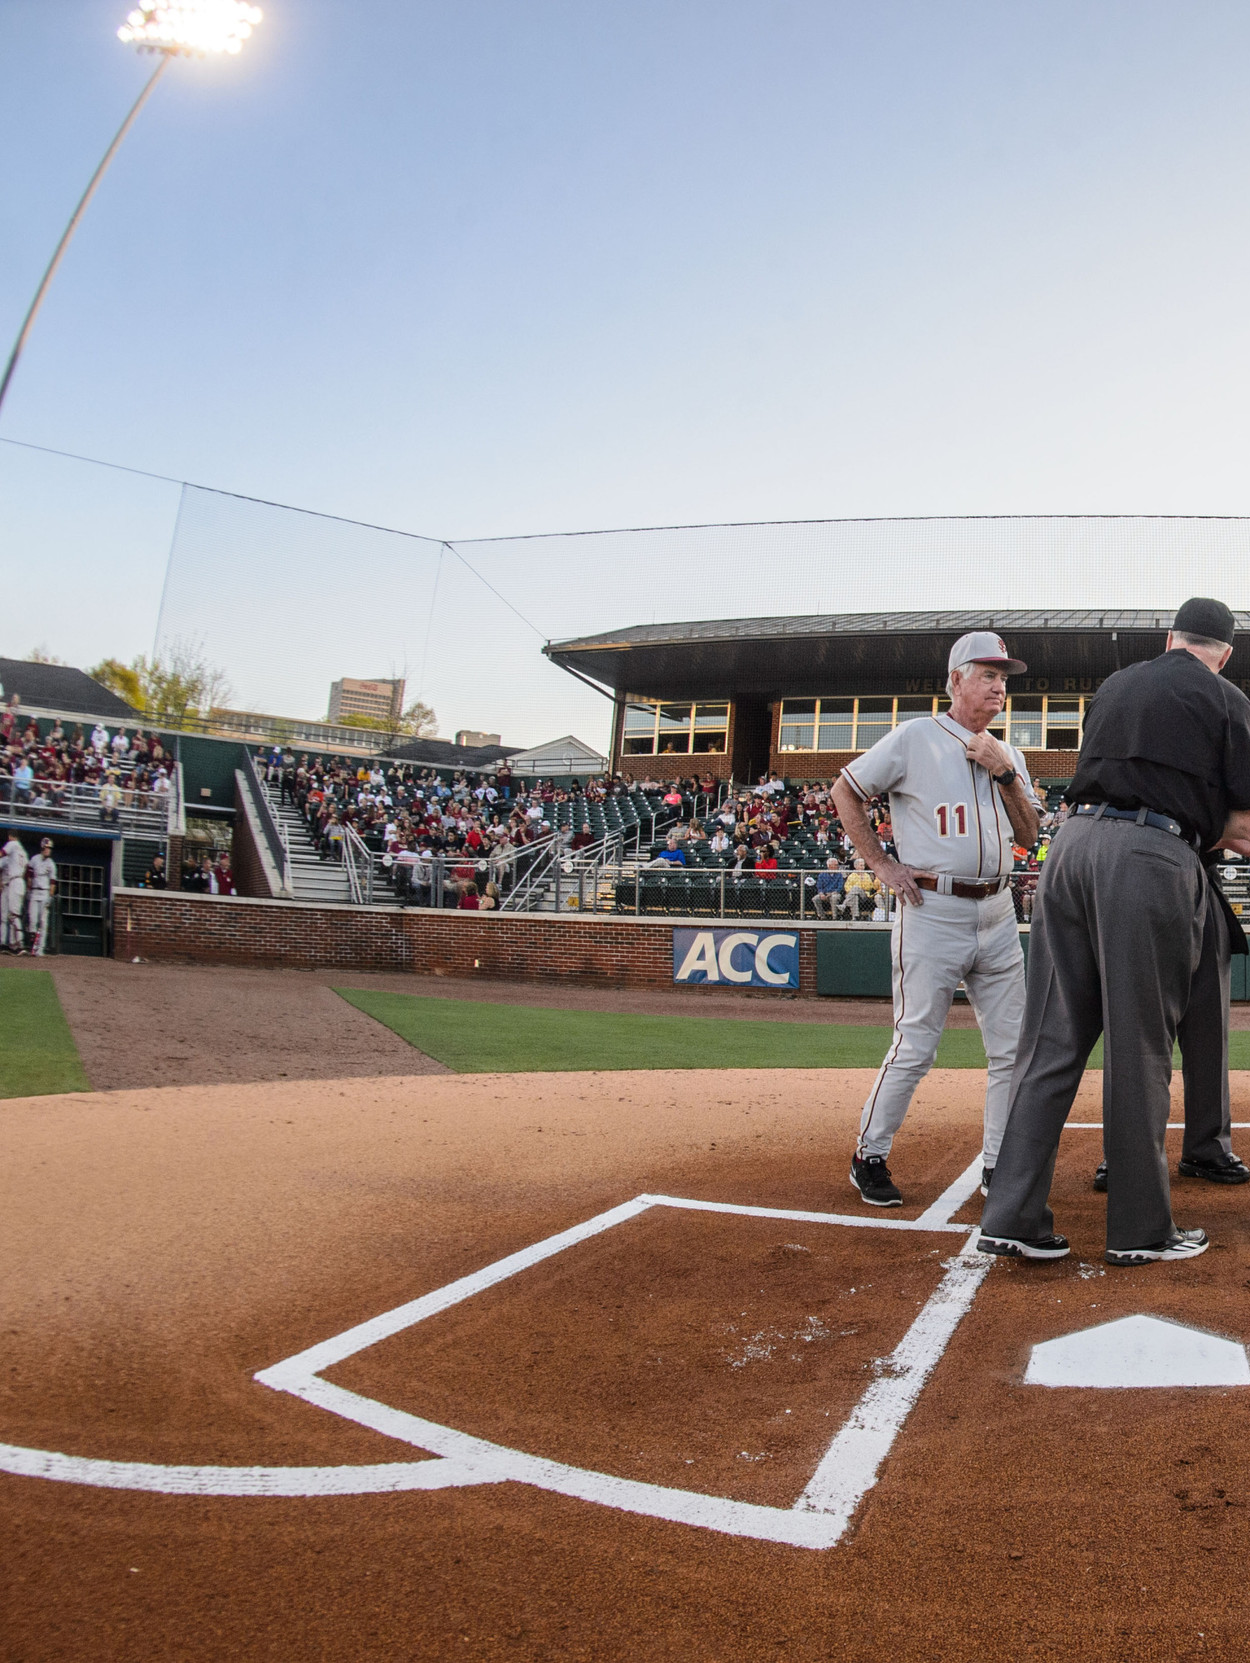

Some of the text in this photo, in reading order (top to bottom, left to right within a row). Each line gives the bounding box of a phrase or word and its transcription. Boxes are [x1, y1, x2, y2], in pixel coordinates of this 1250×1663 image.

[1025, 677, 1049, 692] TO
[934, 802, 969, 838] 11
[675, 932, 797, 984] ACC
